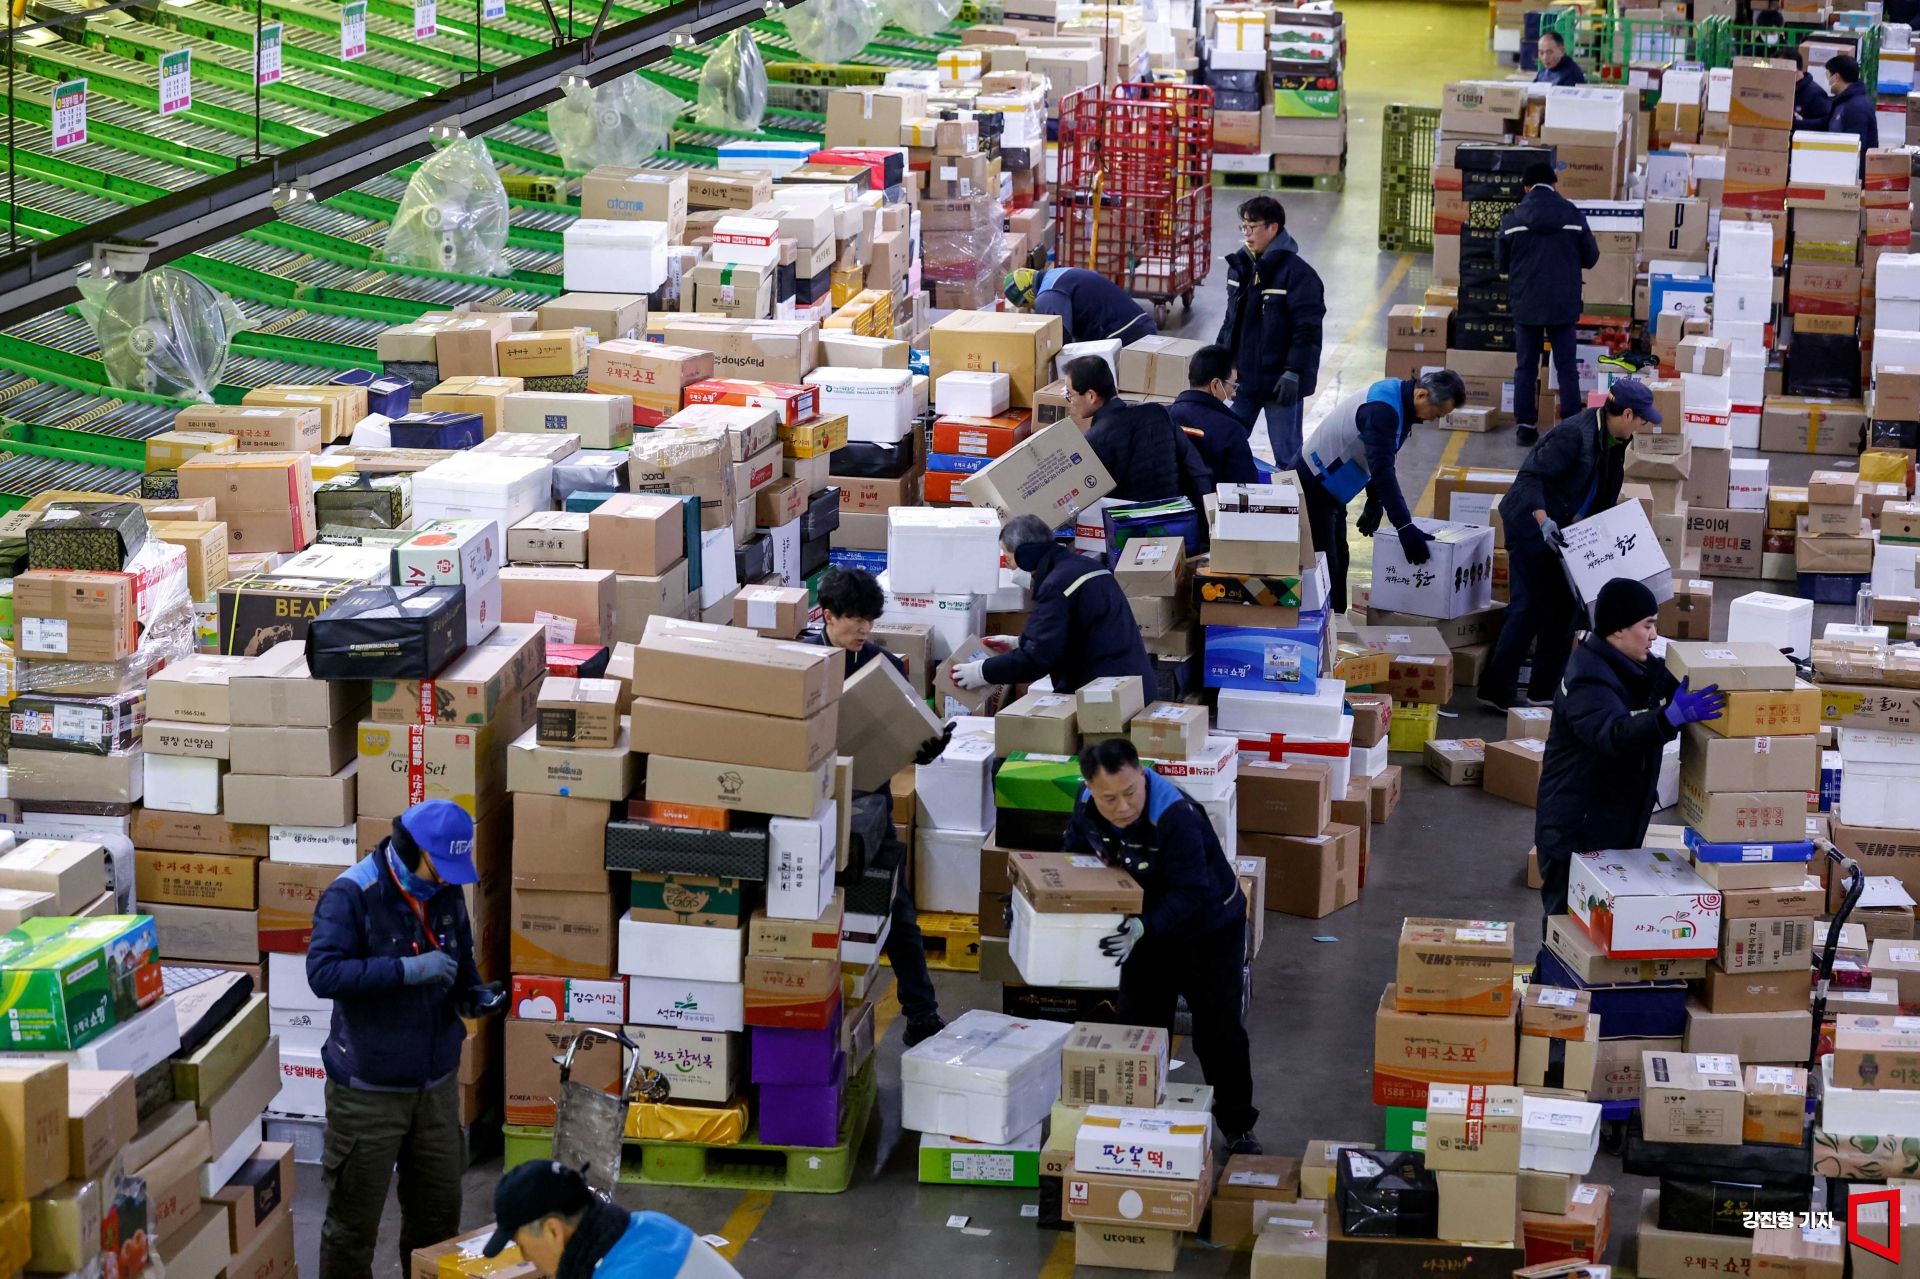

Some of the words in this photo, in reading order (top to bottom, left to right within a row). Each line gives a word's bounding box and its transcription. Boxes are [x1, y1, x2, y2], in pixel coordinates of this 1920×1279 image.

[721, 355, 765, 368] PlayShop
[606, 367, 630, 379] 우체국
[632, 369, 656, 385] 소포
[1702, 534, 1752, 551] 해병대로
[160, 736, 179, 748] 평창
[183, 737, 214, 749] 산양삼
[425, 761, 448, 777] Set
[1866, 843, 1898, 857] EMS
[666, 894, 699, 907] EGGS
[1426, 953, 1454, 966] EMS
[1735, 955, 1744, 968] LG
[785, 975, 806, 987] 소포
[572, 991, 616, 1004] 장수사과
[656, 1007, 683, 1020] 석대
[1404, 1045, 1439, 1059] 우체국
[1442, 1045, 1477, 1062] 소포
[284, 1063, 327, 1079] 당일배송
[1139, 1060, 1148, 1073] LG
[509, 1094, 530, 1102] KOREA
[1683, 1256, 1719, 1270] 우체국
